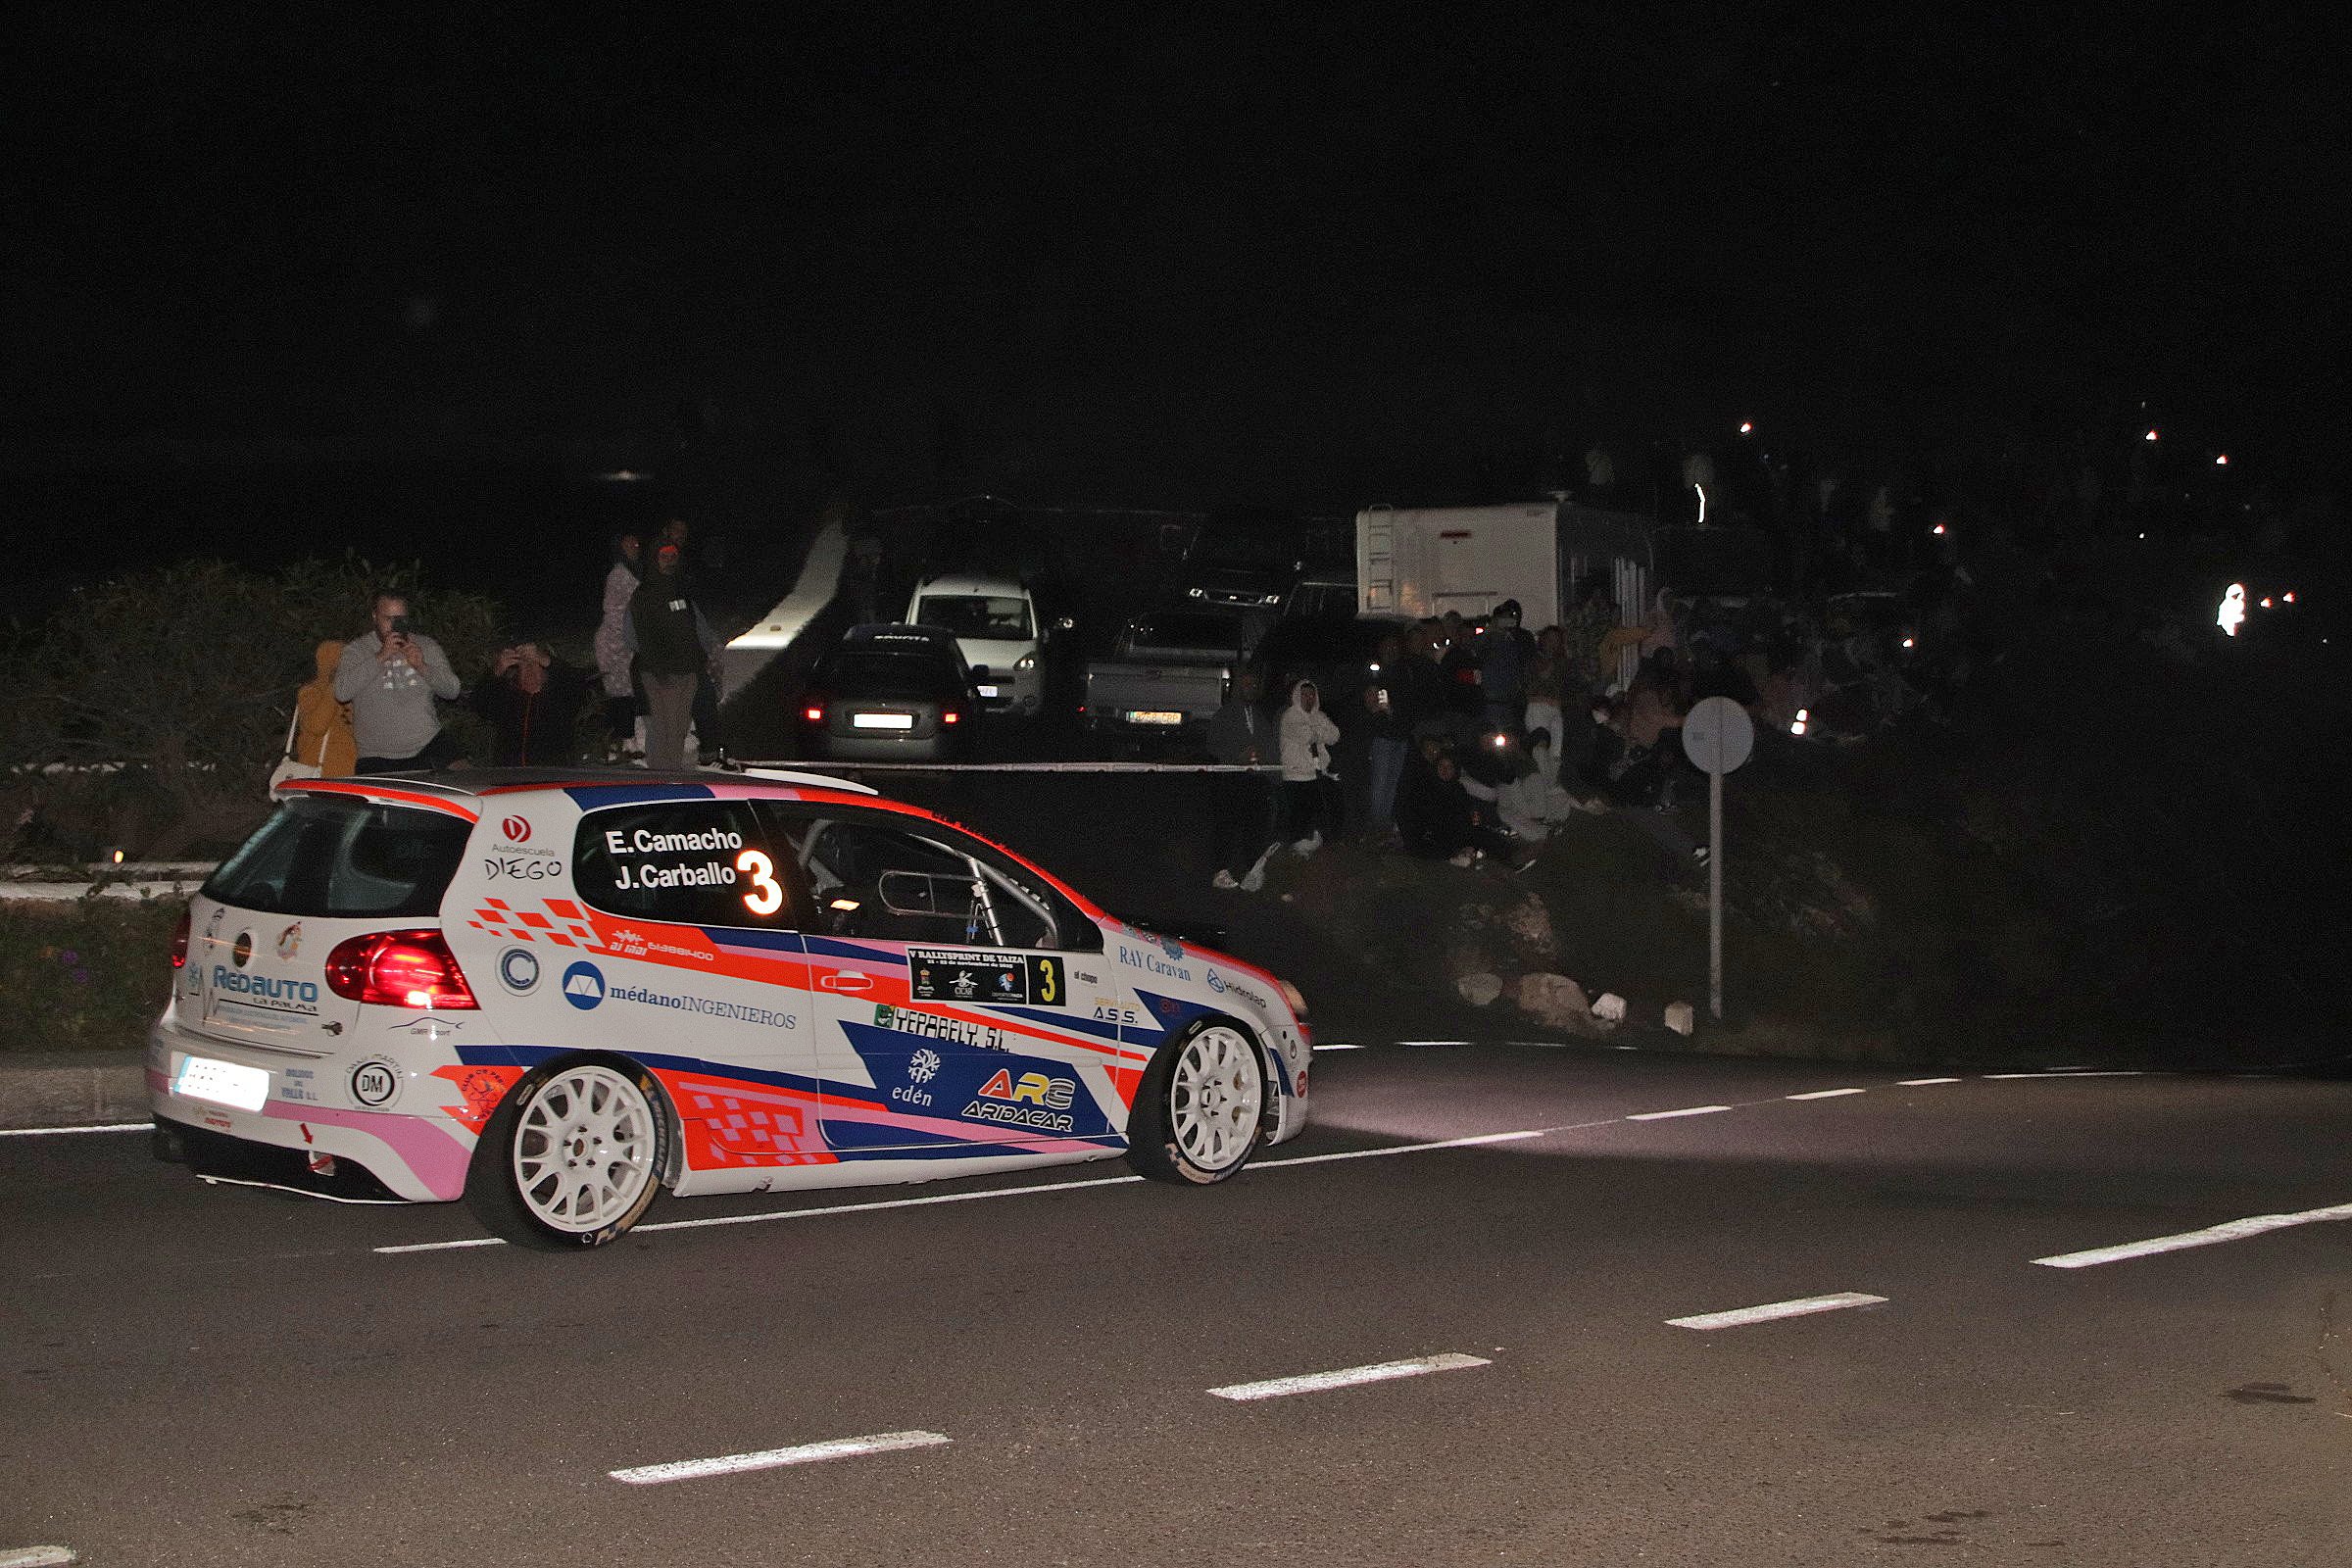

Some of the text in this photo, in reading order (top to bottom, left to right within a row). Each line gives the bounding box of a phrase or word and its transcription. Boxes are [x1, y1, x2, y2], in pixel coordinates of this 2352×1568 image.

[491, 843, 556, 858] Autoescuela
[606, 827, 743, 855] E.Camacho
[484, 858, 563, 880] DIEGO
[614, 862, 737, 890] J.Carballo
[736, 849, 784, 915] 3
[908, 950, 1025, 964] V RALLYSPRINT DE YAIZA
[1119, 945, 1192, 982] RAY Caravan
[1040, 959, 1055, 1003] 3
[610, 984, 797, 1030] médanoINGENIEROS
[361, 1074, 384, 1094] DM
[892, 1084, 933, 1107] edén
[960, 1100, 1073, 1133] ARIDACAR
